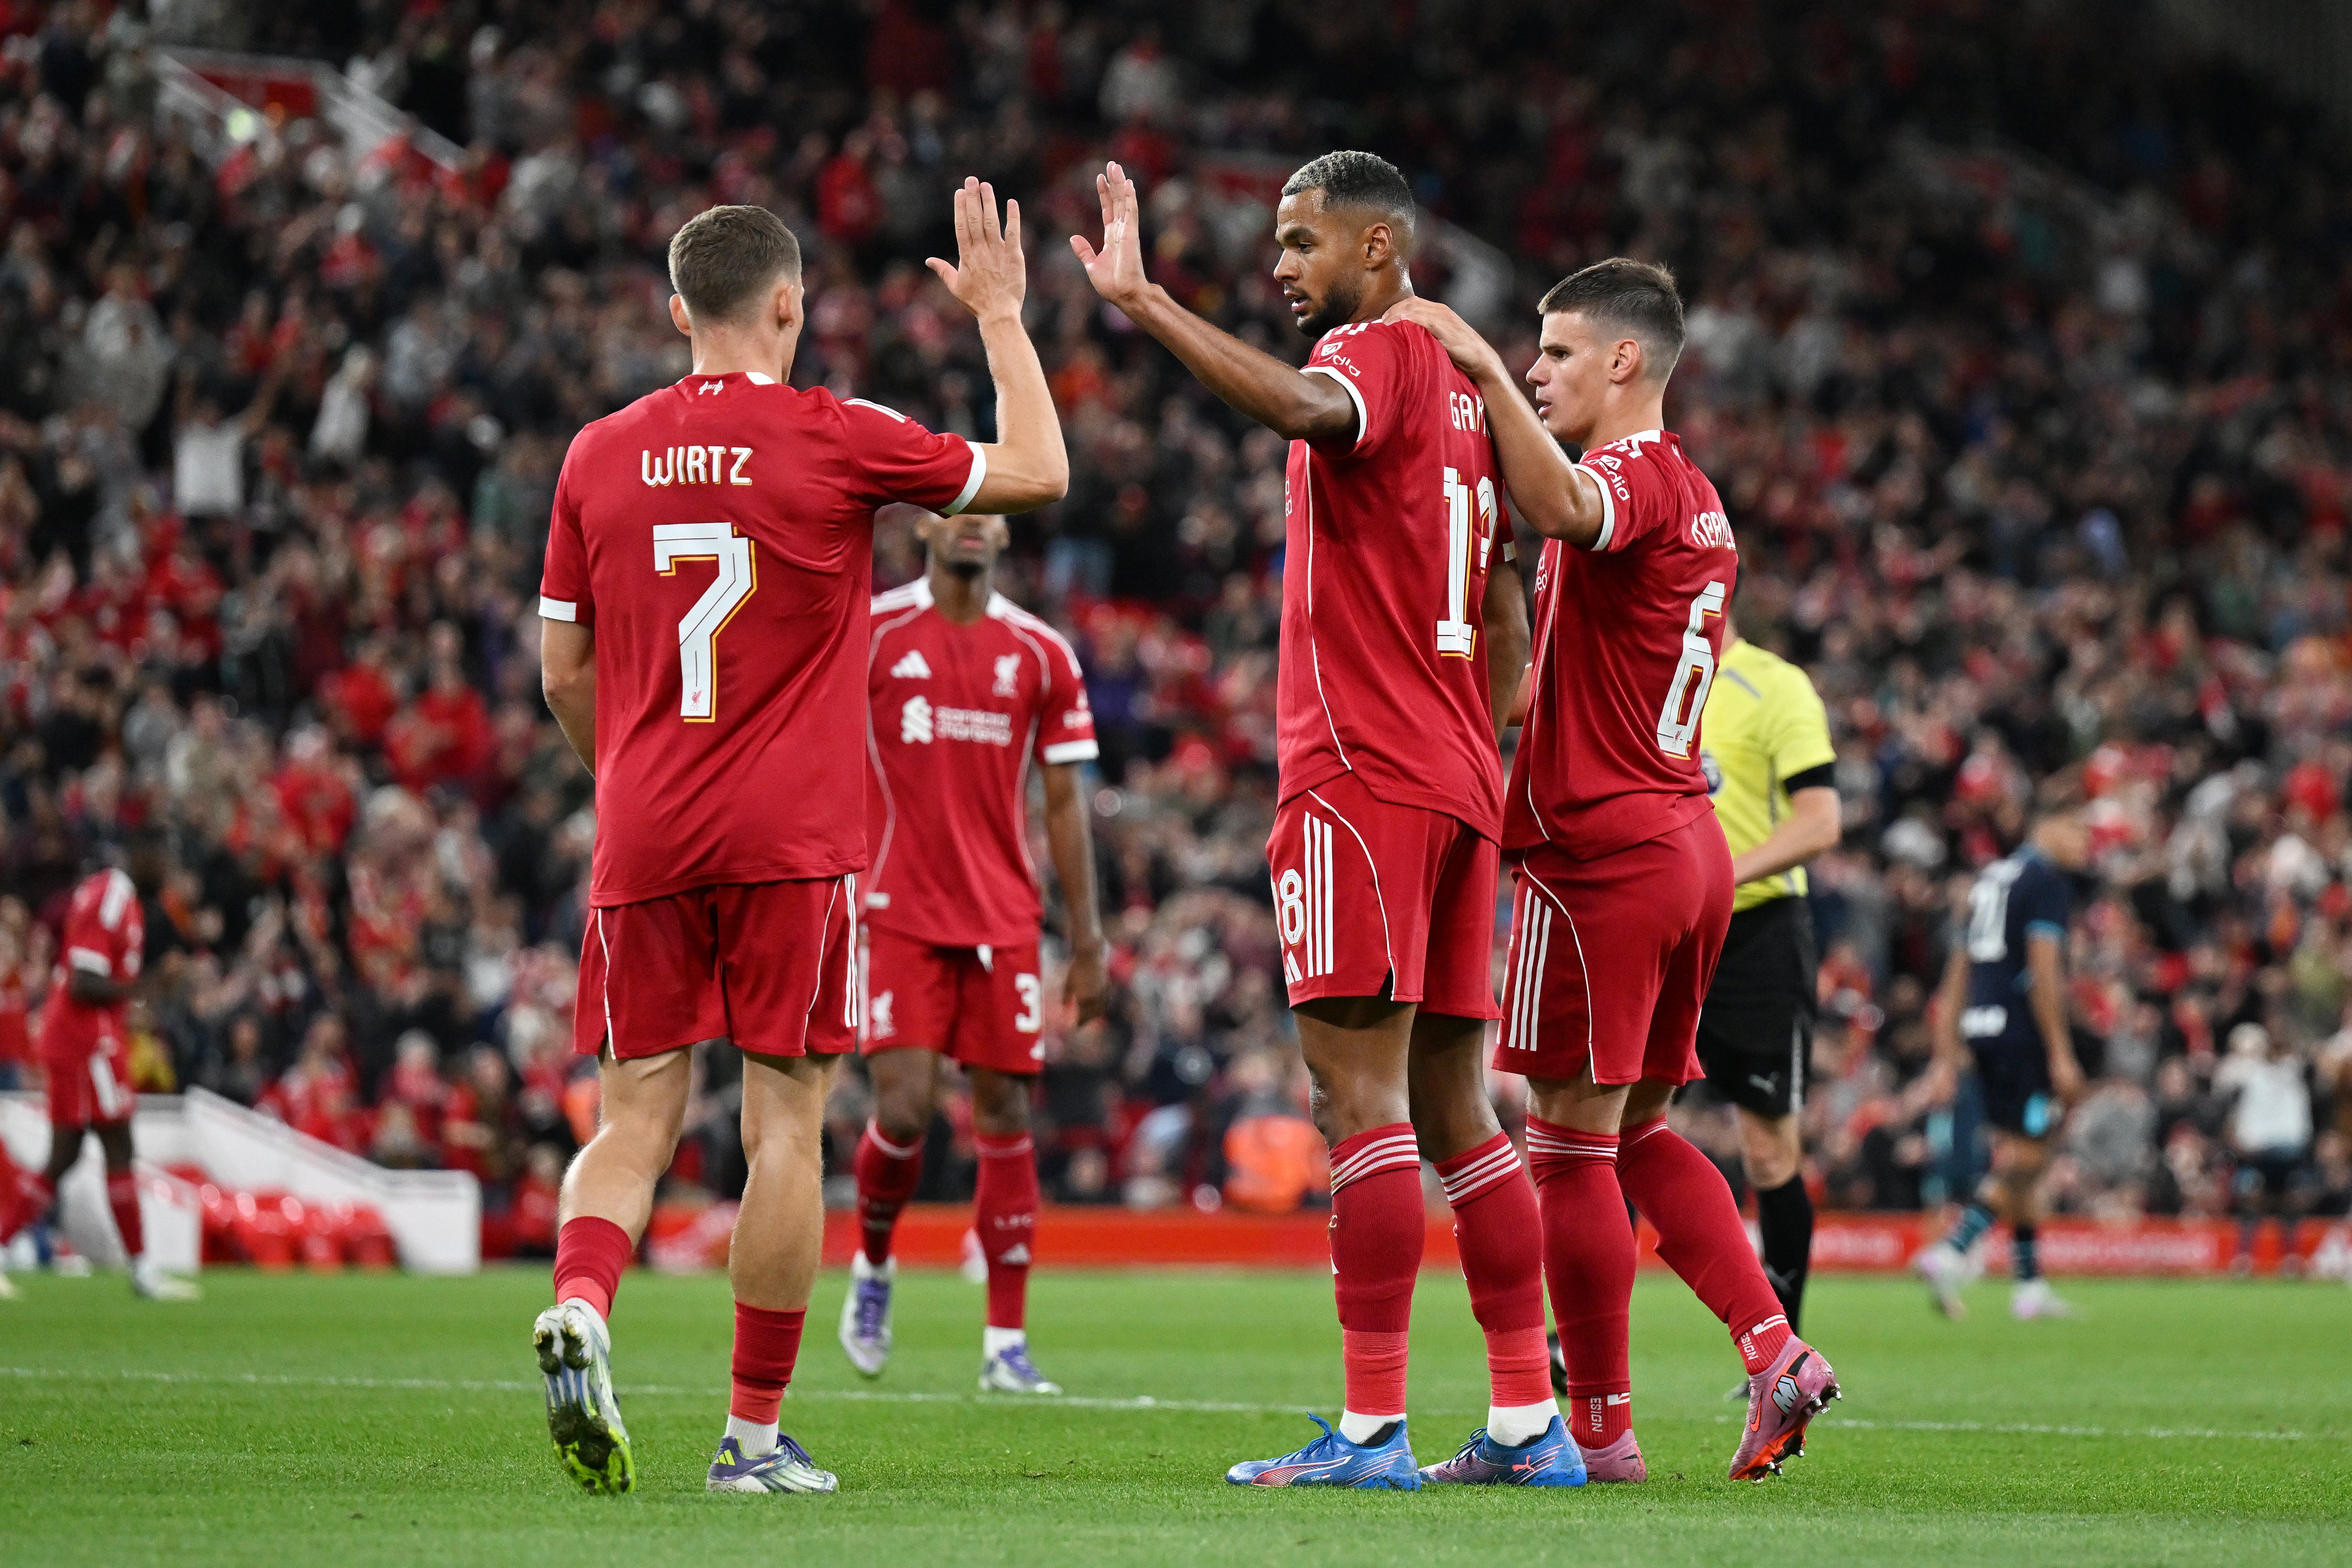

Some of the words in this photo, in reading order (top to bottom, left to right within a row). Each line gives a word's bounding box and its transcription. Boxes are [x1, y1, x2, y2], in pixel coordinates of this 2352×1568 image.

[642, 445, 753, 487] WIRTZ
[653, 522, 757, 722] 7
[1657, 580, 1725, 760] 6
